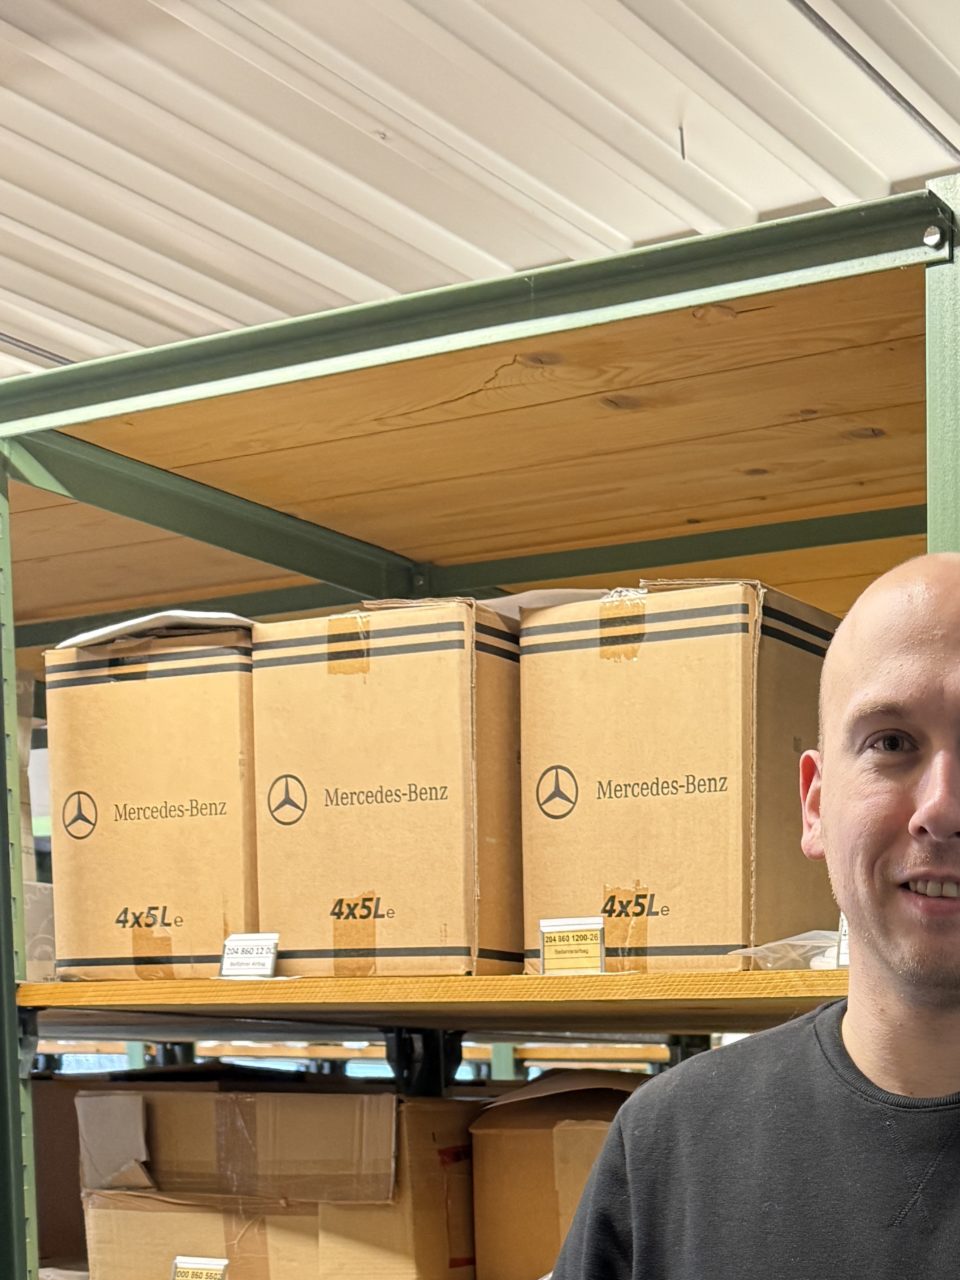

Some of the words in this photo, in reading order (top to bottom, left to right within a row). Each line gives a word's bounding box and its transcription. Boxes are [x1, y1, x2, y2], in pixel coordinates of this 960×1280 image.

[324, 782, 449, 808] Mercedes-Benz
[596, 773, 729, 800] Mercedes-Benz
[113, 799, 228, 822] Mercedes-Benz
